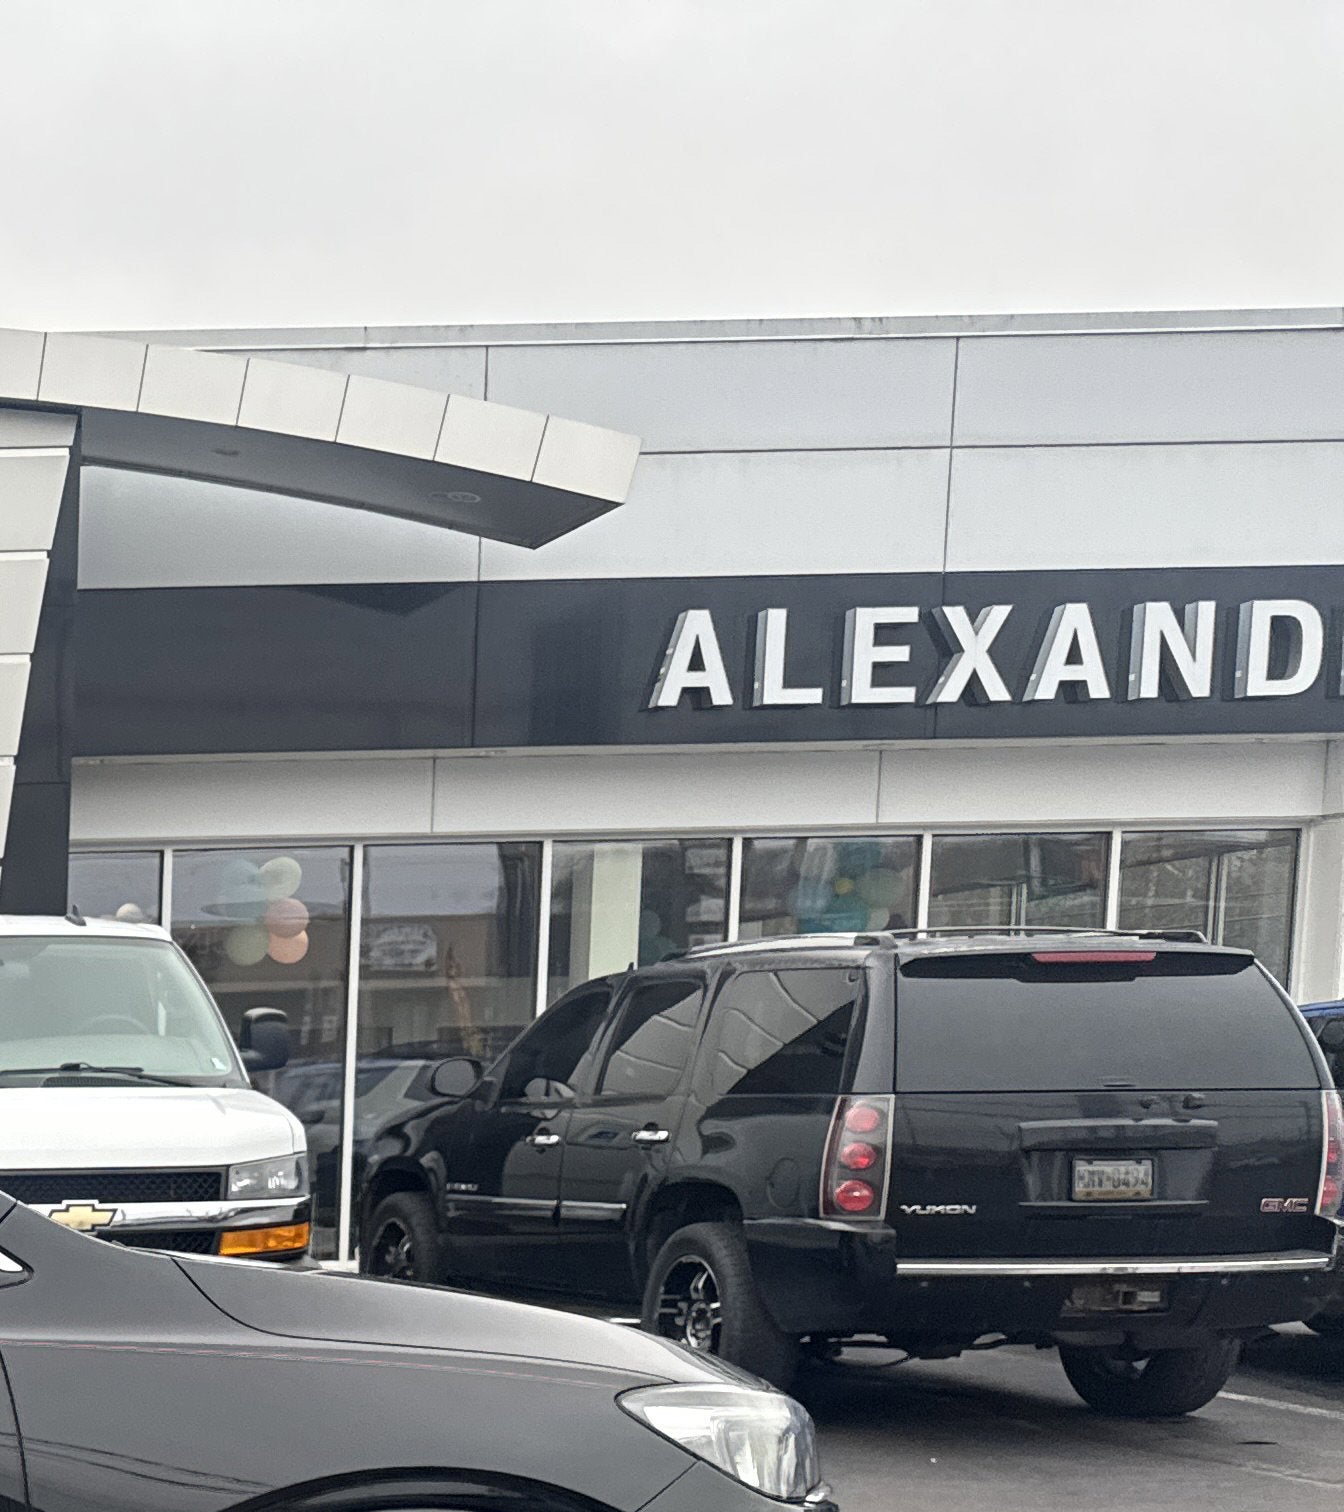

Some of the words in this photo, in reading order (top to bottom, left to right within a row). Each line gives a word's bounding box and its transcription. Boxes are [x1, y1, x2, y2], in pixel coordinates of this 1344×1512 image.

[648, 598, 1344, 709] ALEXAND
[899, 1204, 977, 1215] YUKON
[1259, 1197, 1310, 1213] GMC
